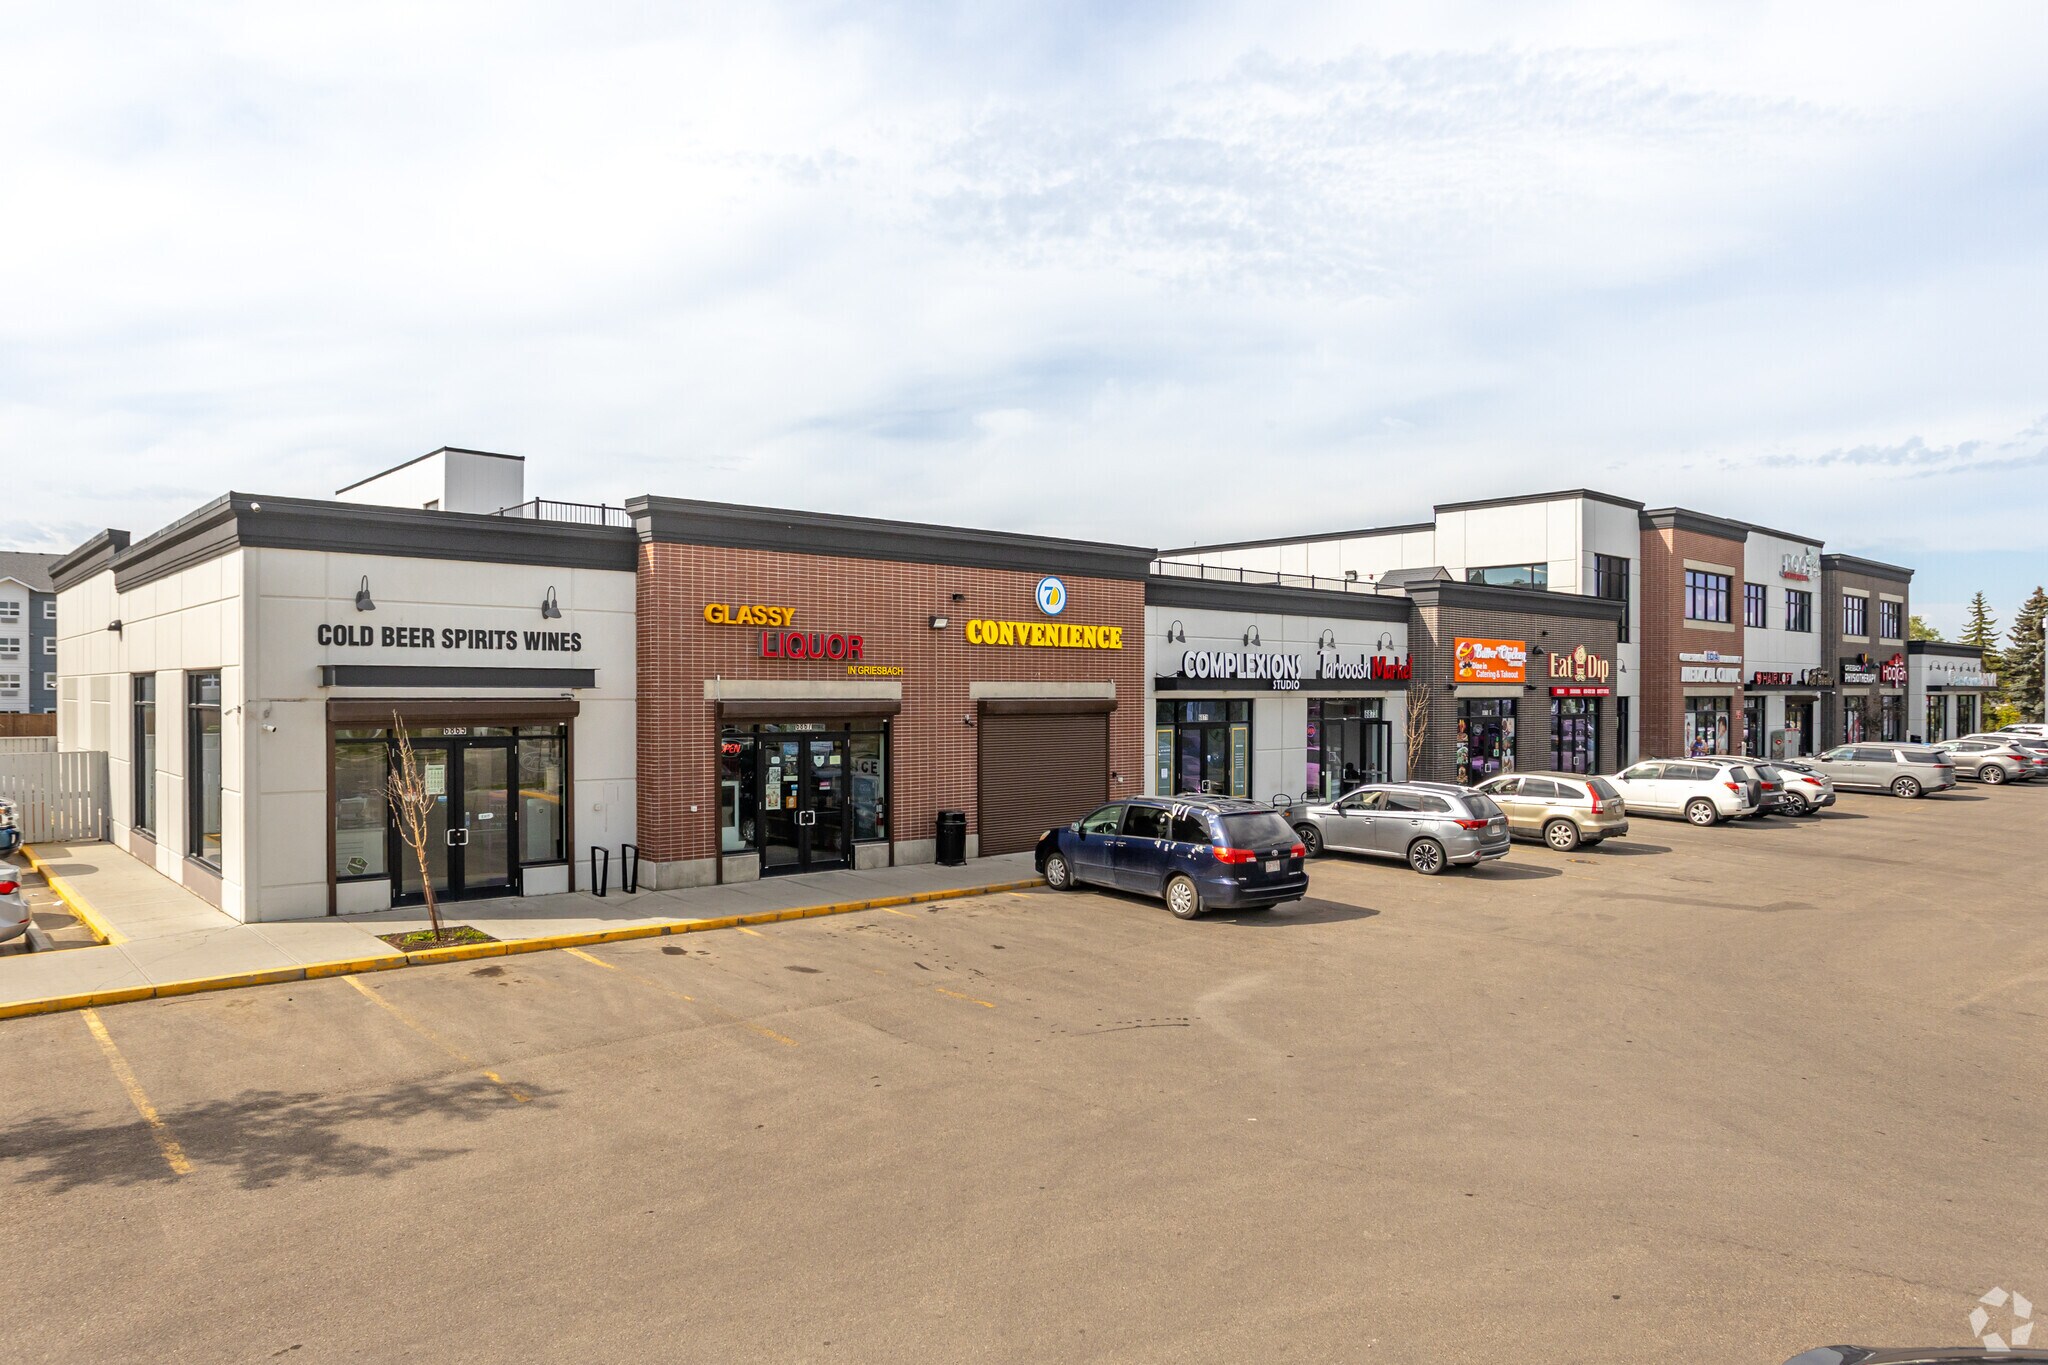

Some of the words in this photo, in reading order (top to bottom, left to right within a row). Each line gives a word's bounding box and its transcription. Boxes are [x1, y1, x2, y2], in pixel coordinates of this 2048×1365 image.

[703, 602, 797, 627] GLASSY
[317, 623, 375, 648] COLD
[381, 626, 436, 649] BEER
[441, 628, 518, 651] SPIRITS
[523, 630, 583, 652] WINES
[758, 630, 865, 661] LIQUOR
[965, 618, 1124, 650] CONVENIENCE
[847, 665, 856, 675] IN
[857, 665, 904, 676] GRIESBACH
[1183, 650, 1303, 679] COMPLEXIONS
[1317, 650, 1372, 679] Tarboosh
[1371, 654, 1414, 680] Market
[1476, 670, 1496, 680] Catering
[1500, 670, 1519, 679] Takeout
[1549, 652, 1573, 678] Eat
[1587, 654, 1610, 683] Dip
[1272, 680, 1301, 690] STUDIO
